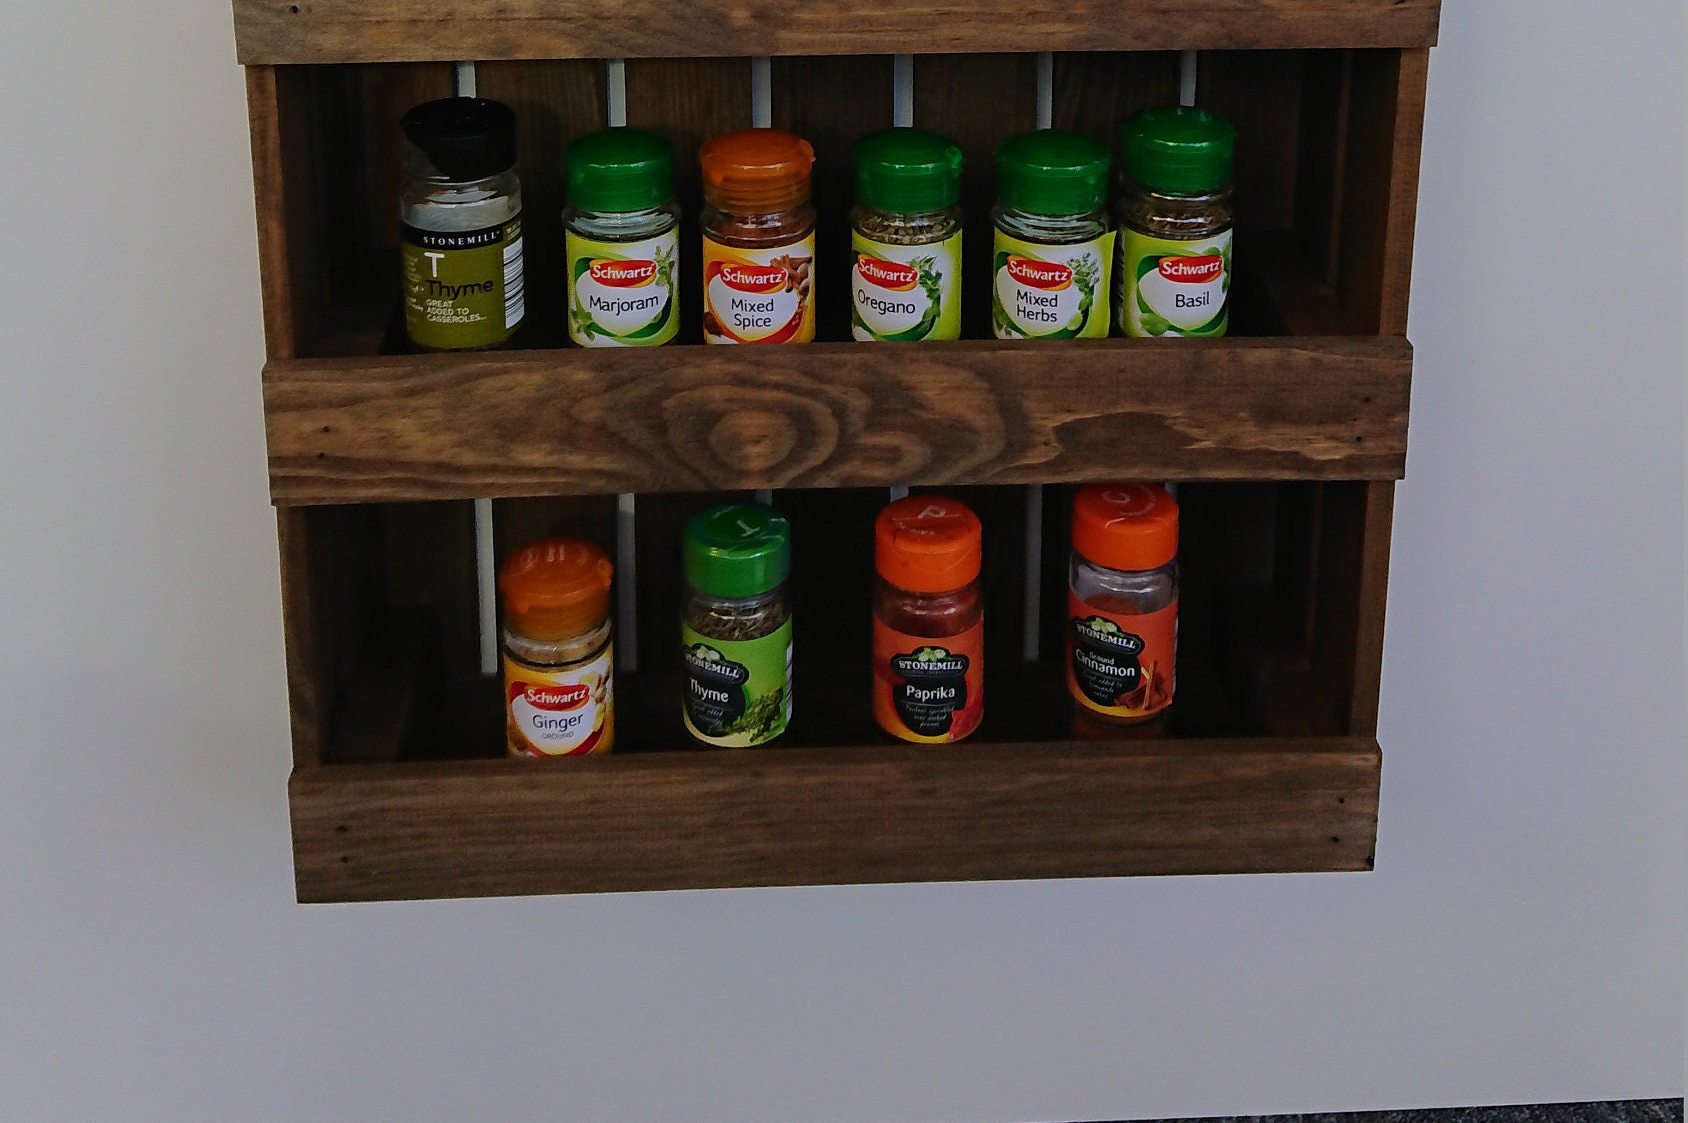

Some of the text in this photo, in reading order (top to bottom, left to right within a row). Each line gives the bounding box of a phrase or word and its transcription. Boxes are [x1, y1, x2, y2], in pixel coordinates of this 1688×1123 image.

[423, 231, 497, 246] STONEMILL
[424, 252, 445, 278] T
[592, 264, 653, 280] Schwartz
[859, 259, 913, 282] Schwartz
[1009, 261, 1069, 282] Schwartz
[1161, 261, 1220, 276] Schwartz
[722, 268, 782, 285] Schwartz
[425, 279, 495, 301] Thyme
[1016, 288, 1058, 308] Mixed
[1175, 290, 1210, 308] Basil
[426, 298, 454, 308] GREAT
[426, 306, 470, 316] ADDED TO
[589, 295, 659, 316] Marjoram
[731, 298, 774, 313] Mixed
[858, 289, 916, 315] Oregano
[734, 313, 772, 330] Spice
[1016, 304, 1058, 323] Herbs
[1076, 623, 1136, 649] STONEMILL
[899, 660, 963, 671] STONEMILL
[1075, 649, 1135, 677] Cinnamon
[1089, 651, 1115, 665] Ground
[527, 688, 586, 704] Schwartz
[689, 677, 730, 703] Thyme
[906, 685, 956, 703] Paprika
[532, 713, 584, 732] Ginger
[541, 731, 575, 740] GROUND
